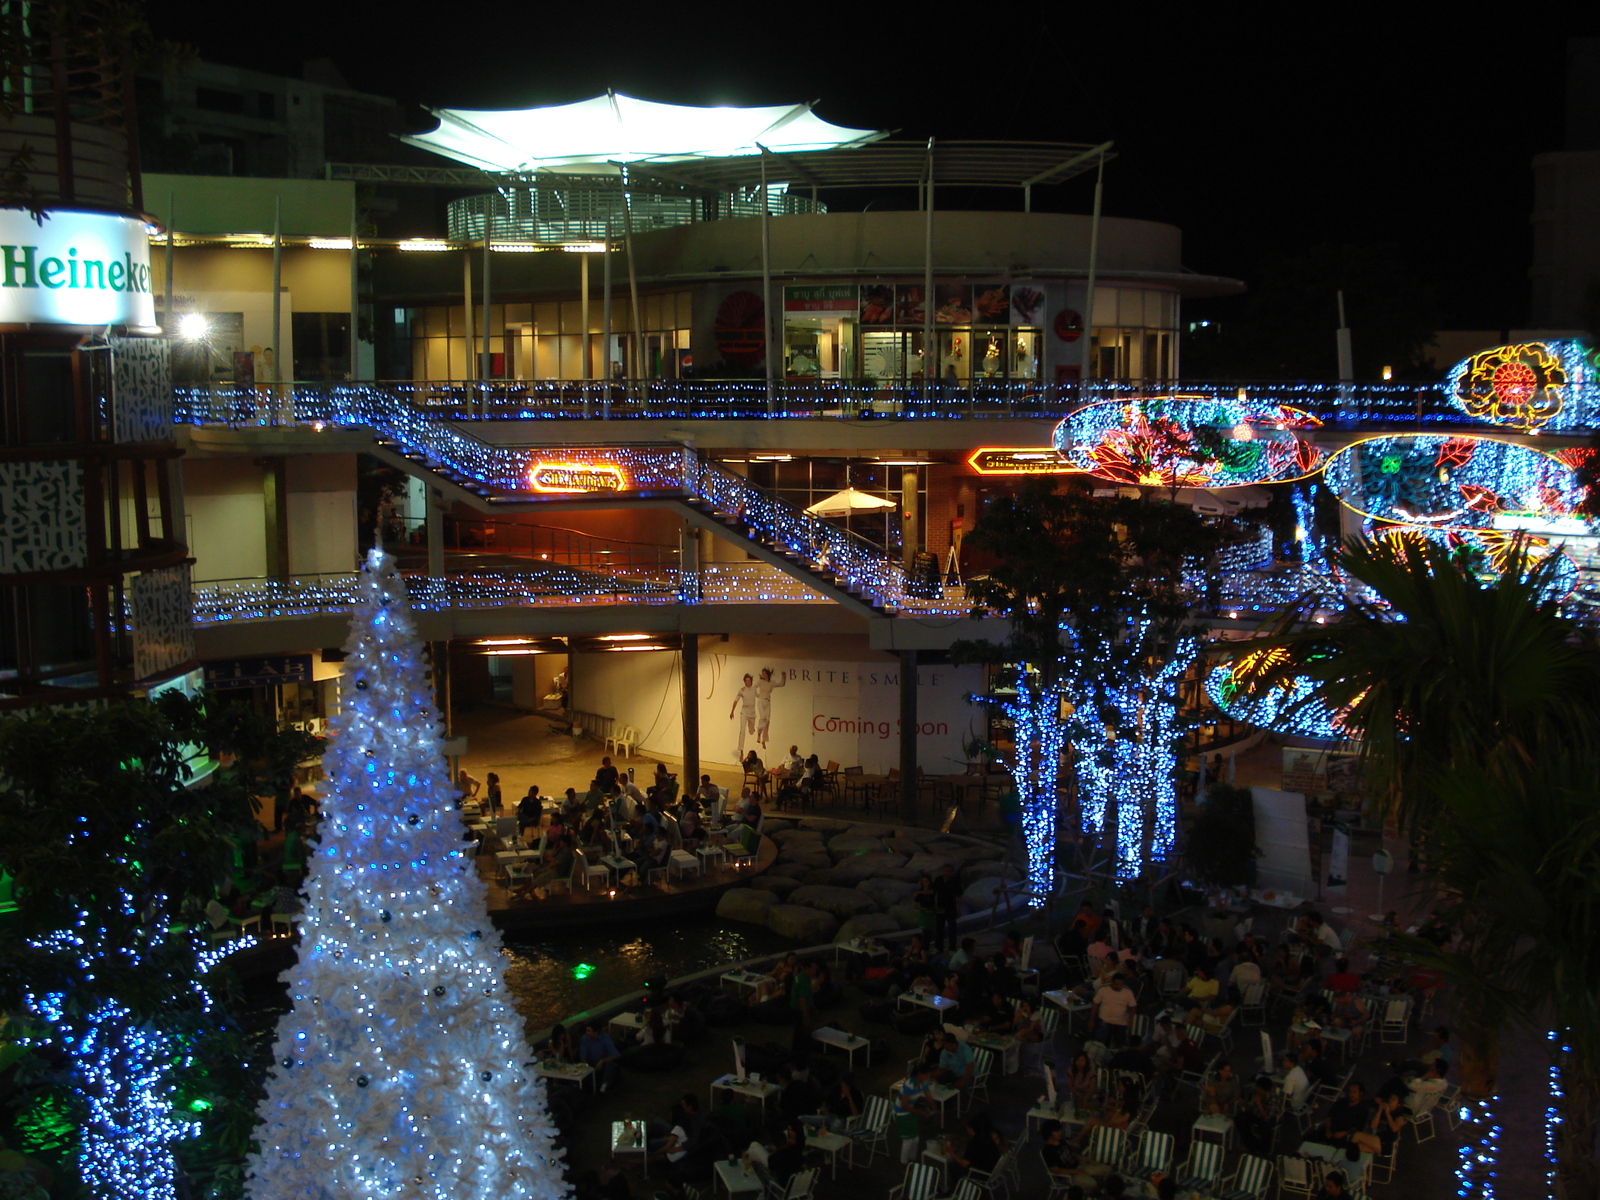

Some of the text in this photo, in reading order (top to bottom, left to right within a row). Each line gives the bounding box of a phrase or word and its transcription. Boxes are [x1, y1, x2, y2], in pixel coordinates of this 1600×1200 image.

[789, 669, 939, 686] BRITE SMLE
[813, 714, 948, 740] Coming on
